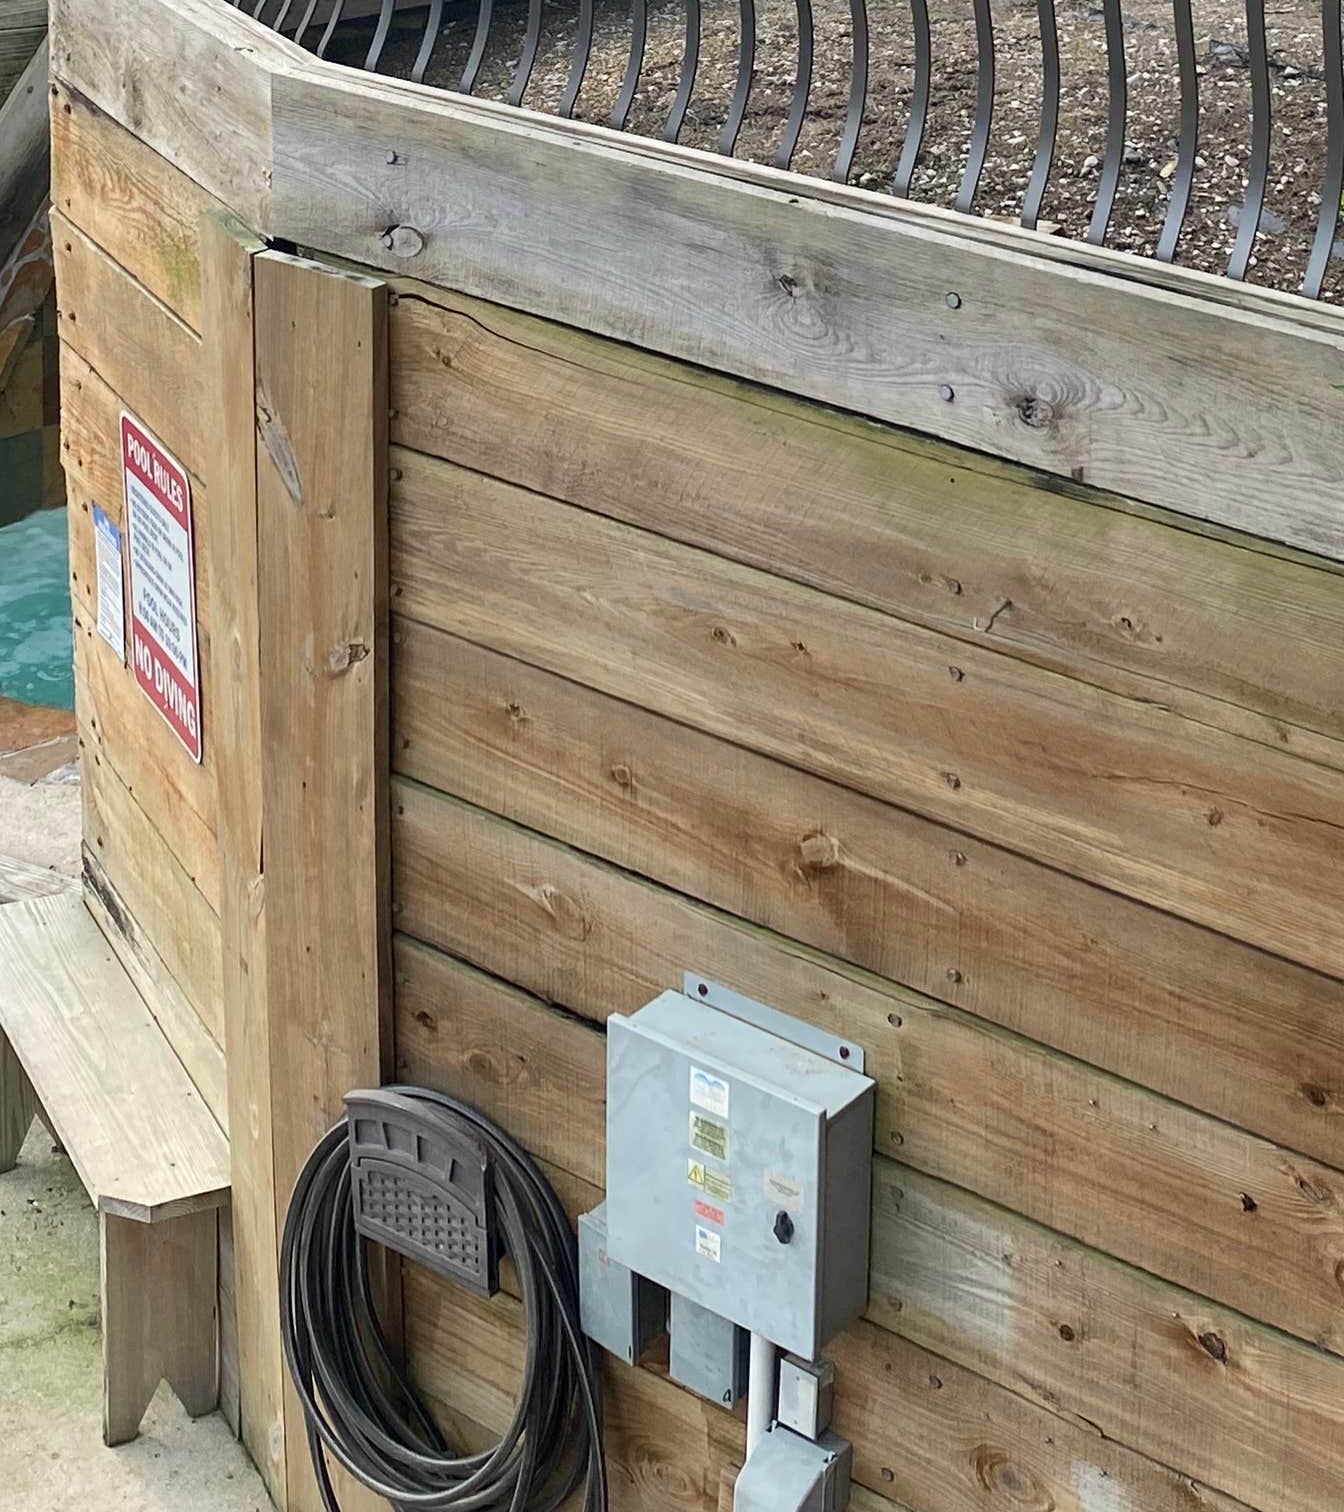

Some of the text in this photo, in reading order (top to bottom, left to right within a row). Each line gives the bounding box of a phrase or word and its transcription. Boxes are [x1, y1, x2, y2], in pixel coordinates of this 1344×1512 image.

[127, 433, 153, 480] POOL
[154, 458, 183, 513] RULES
[135, 633, 153, 680] NO
[154, 657, 196, 737] DIVING
